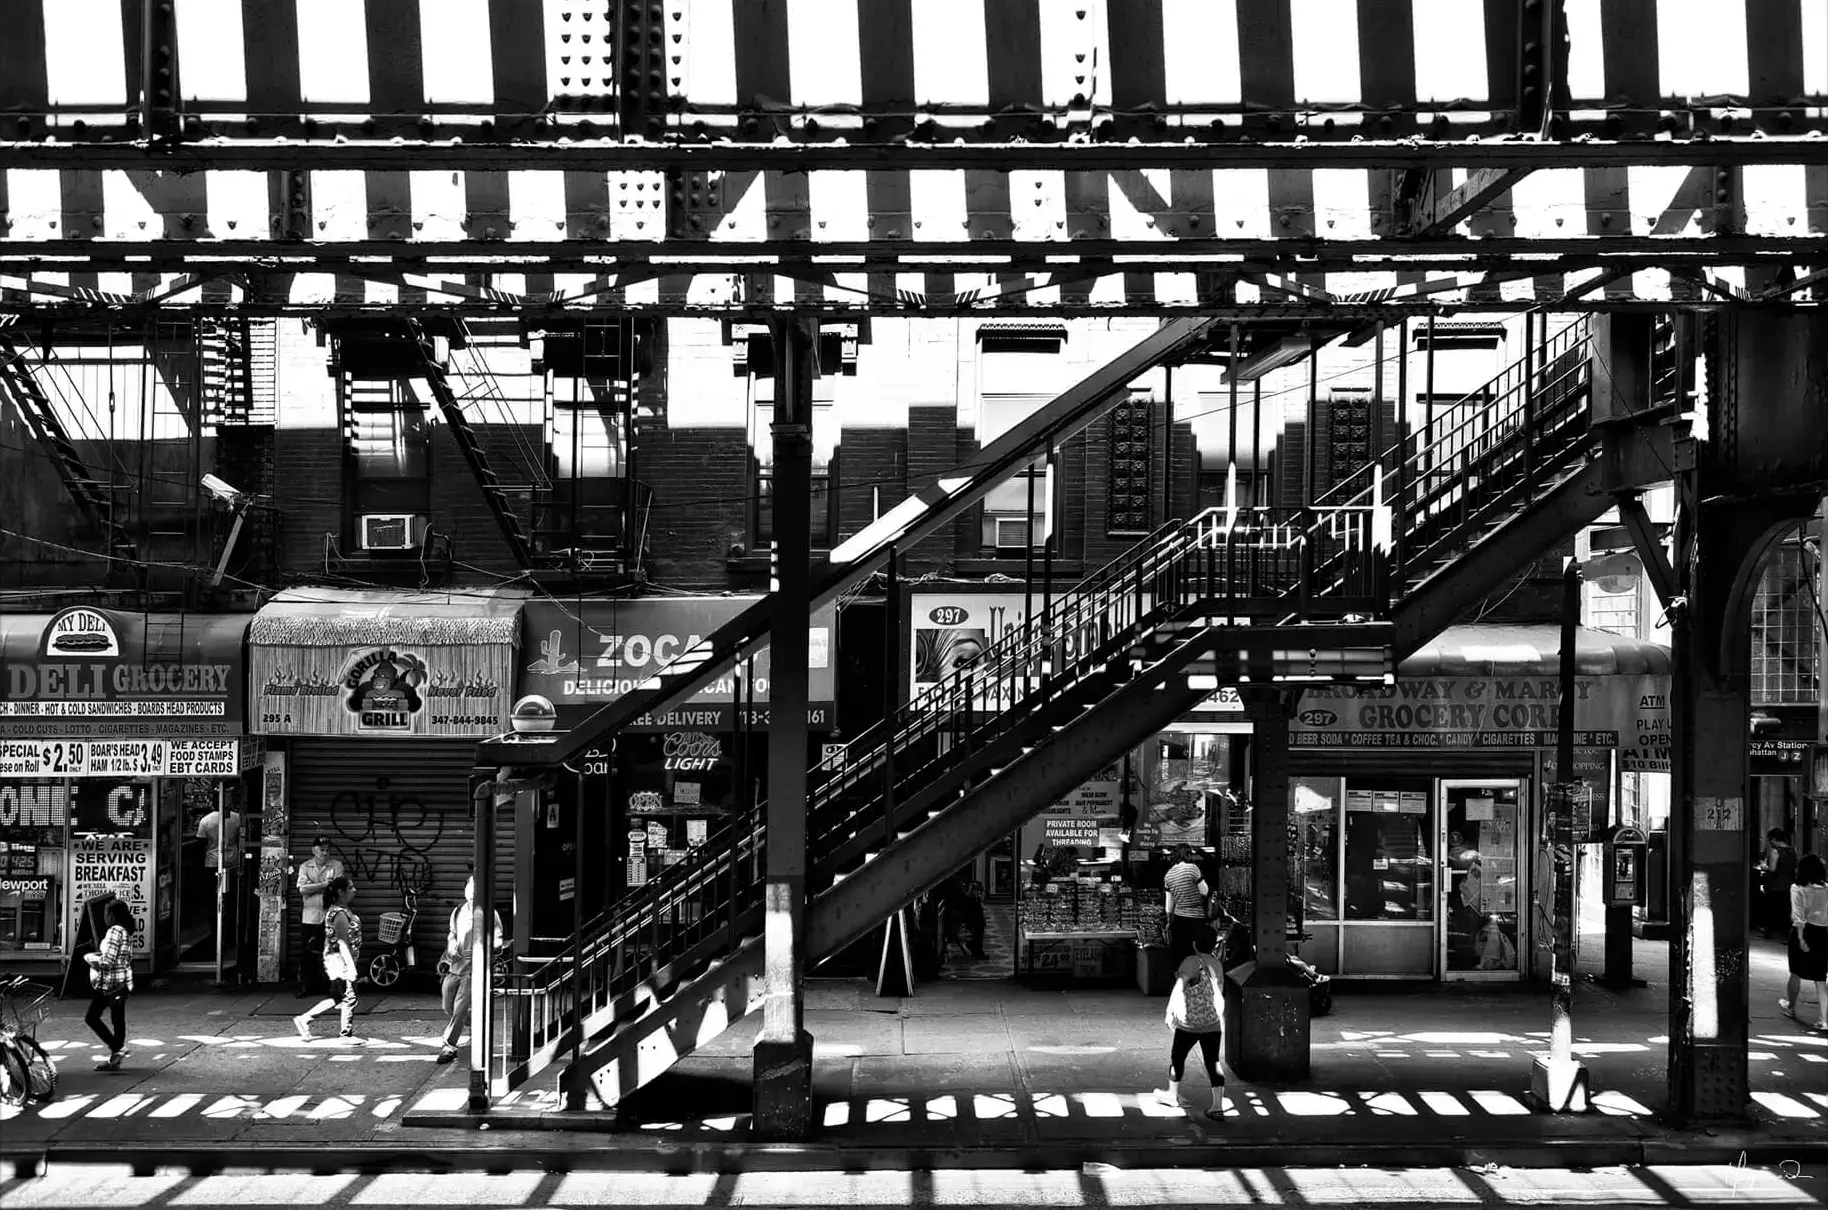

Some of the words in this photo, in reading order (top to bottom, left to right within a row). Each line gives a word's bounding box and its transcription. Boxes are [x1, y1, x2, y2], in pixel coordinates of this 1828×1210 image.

[58, 615, 74, 631] MY
[78, 613, 106, 631] DELI
[937, 609, 960, 623] 297
[346, 652, 397, 689] GORILLA
[8, 664, 106, 698] DELI
[113, 664, 231, 692] GROCERY
[1495, 681, 1594, 699] MARY
[1640, 695, 1666, 707] ATM
[14, 703, 40, 714] DINNER
[44, 703, 59, 714] HOT
[61, 704, 66, 714] &
[68, 703, 86, 714] COLD
[87, 703, 132, 714] SANDWICHES
[138, 703, 164, 714] BOARDS
[166, 703, 185, 714] HEAD
[186, 703, 223, 714] PRODUCTS
[263, 714, 280, 723] 295
[284, 714, 292, 723] A
[362, 713, 408, 726] GRILL
[431, 715, 499, 725] 347-844-9845
[1304, 712, 1334, 724] 297
[1359, 704, 1486, 728] GROCERY
[13, 725, 34, 734] COLD
[37, 725, 59, 734] CUTS
[65, 725, 91, 734] LOTTO
[99, 725, 149, 734] CIGARETTES
[156, 725, 204, 734] MAGAZINES
[212, 725, 230, 734] ETC.
[1636, 719, 1664, 731] PLAY
[170, 741, 188, 750] WE
[191, 741, 234, 750] ACCEPT
[1297, 733, 1318, 745] BEER
[1320, 733, 1343, 745] SODA
[1351, 733, 1382, 745] COFFEE
[1384, 733, 1401, 745] TEA
[1404, 734, 1410, 745] &
[1412, 734, 1438, 746] CHOC.
[1482, 733, 1535, 745] CIGARETTES
[1596, 733, 1615, 745] ETC.
[1764, 741, 1775, 749] Av
[91, 743, 118, 757] BOAR'S
[120, 743, 140, 757] HEAD
[170, 751, 195, 761] FOOD
[198, 751, 234, 761] STAMPS
[14, 763, 23, 773] on
[25, 760, 39, 773] Roll
[91, 759, 108, 772] HAM
[170, 762, 192, 774] EBT
[195, 762, 233, 774] CARDS
[664, 758, 719, 771] LIGHT
[1046, 820, 1075, 829] PRIVATE
[1077, 820, 1097, 829] ROOM
[1045, 829, 1082, 838] AVAILABLE
[1084, 829, 1099, 838] FOR
[81, 841, 105, 851] WE
[112, 841, 142, 851] ARE
[1052, 838, 1092, 847] THREADING
[76, 853, 147, 864] SERVING
[75, 866, 146, 881] BREAKFAST
[0, 878, 48, 893] ewport
